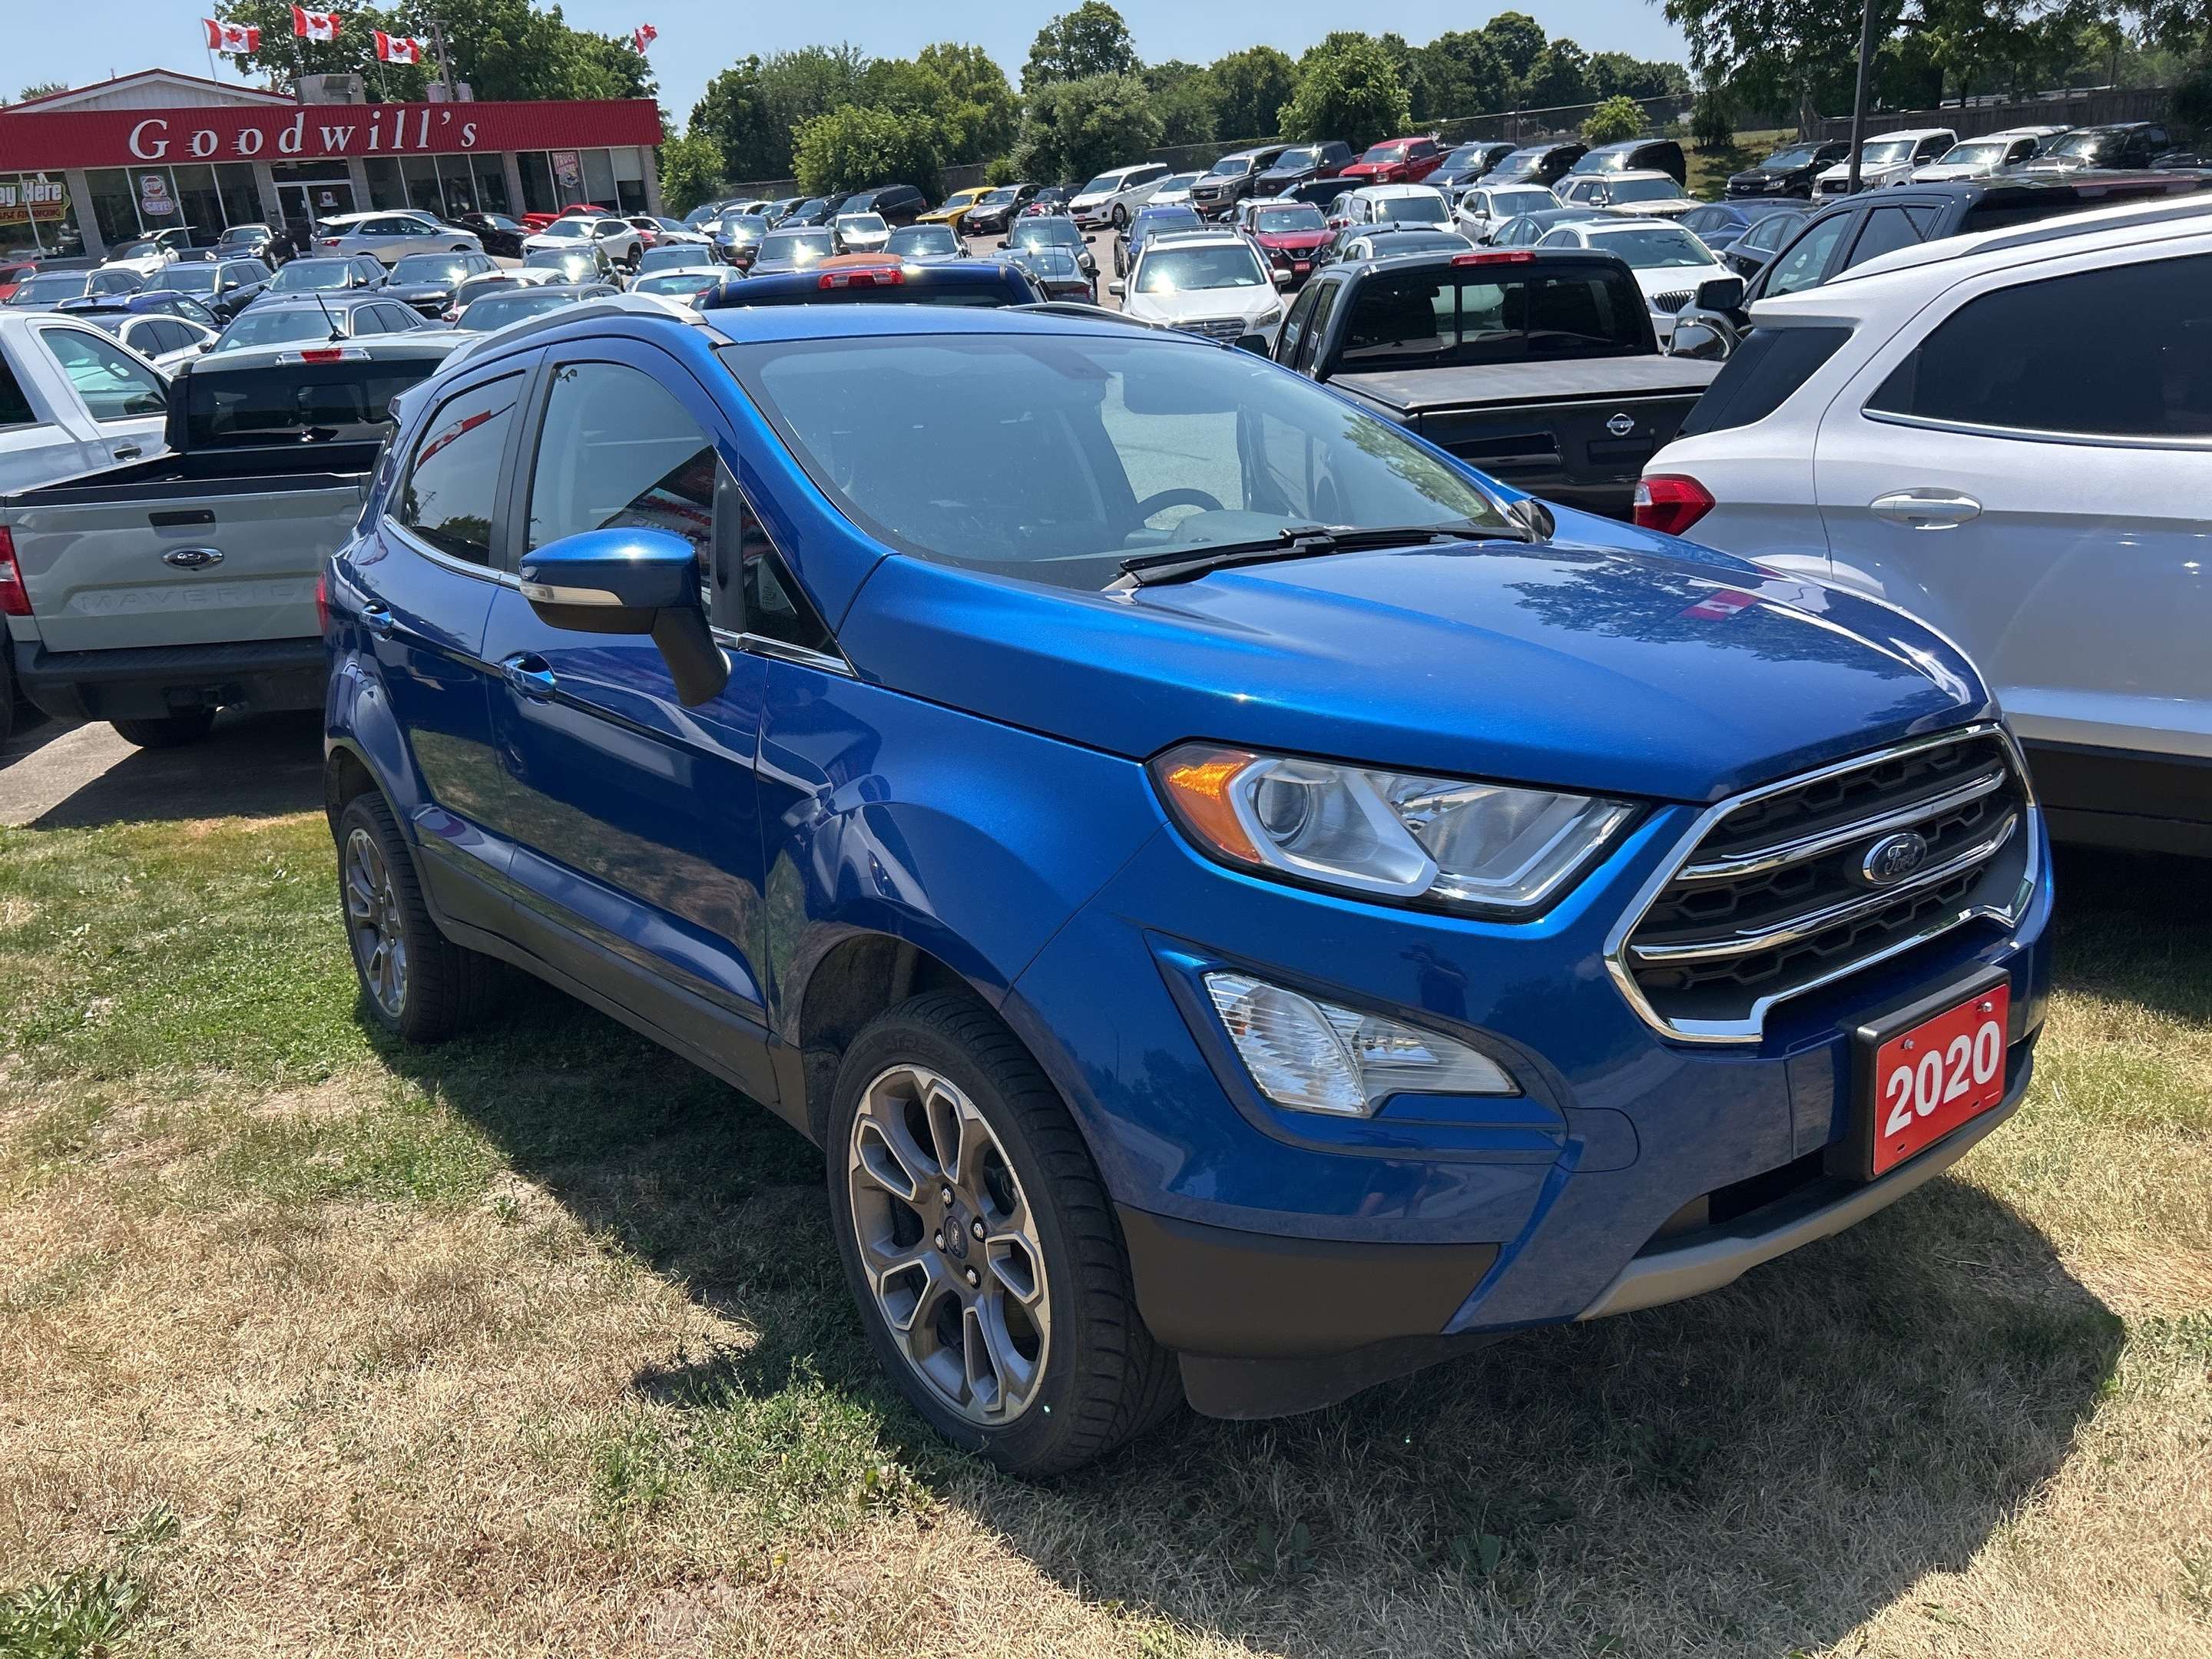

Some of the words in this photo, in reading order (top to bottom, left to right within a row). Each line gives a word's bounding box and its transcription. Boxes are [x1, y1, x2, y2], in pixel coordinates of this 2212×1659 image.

[128, 108, 478, 160] Goodwill's
[21, 181, 62, 202] Here
[80, 581, 316, 611] MAVERIC
[1883, 1020, 2001, 1138] 2020
